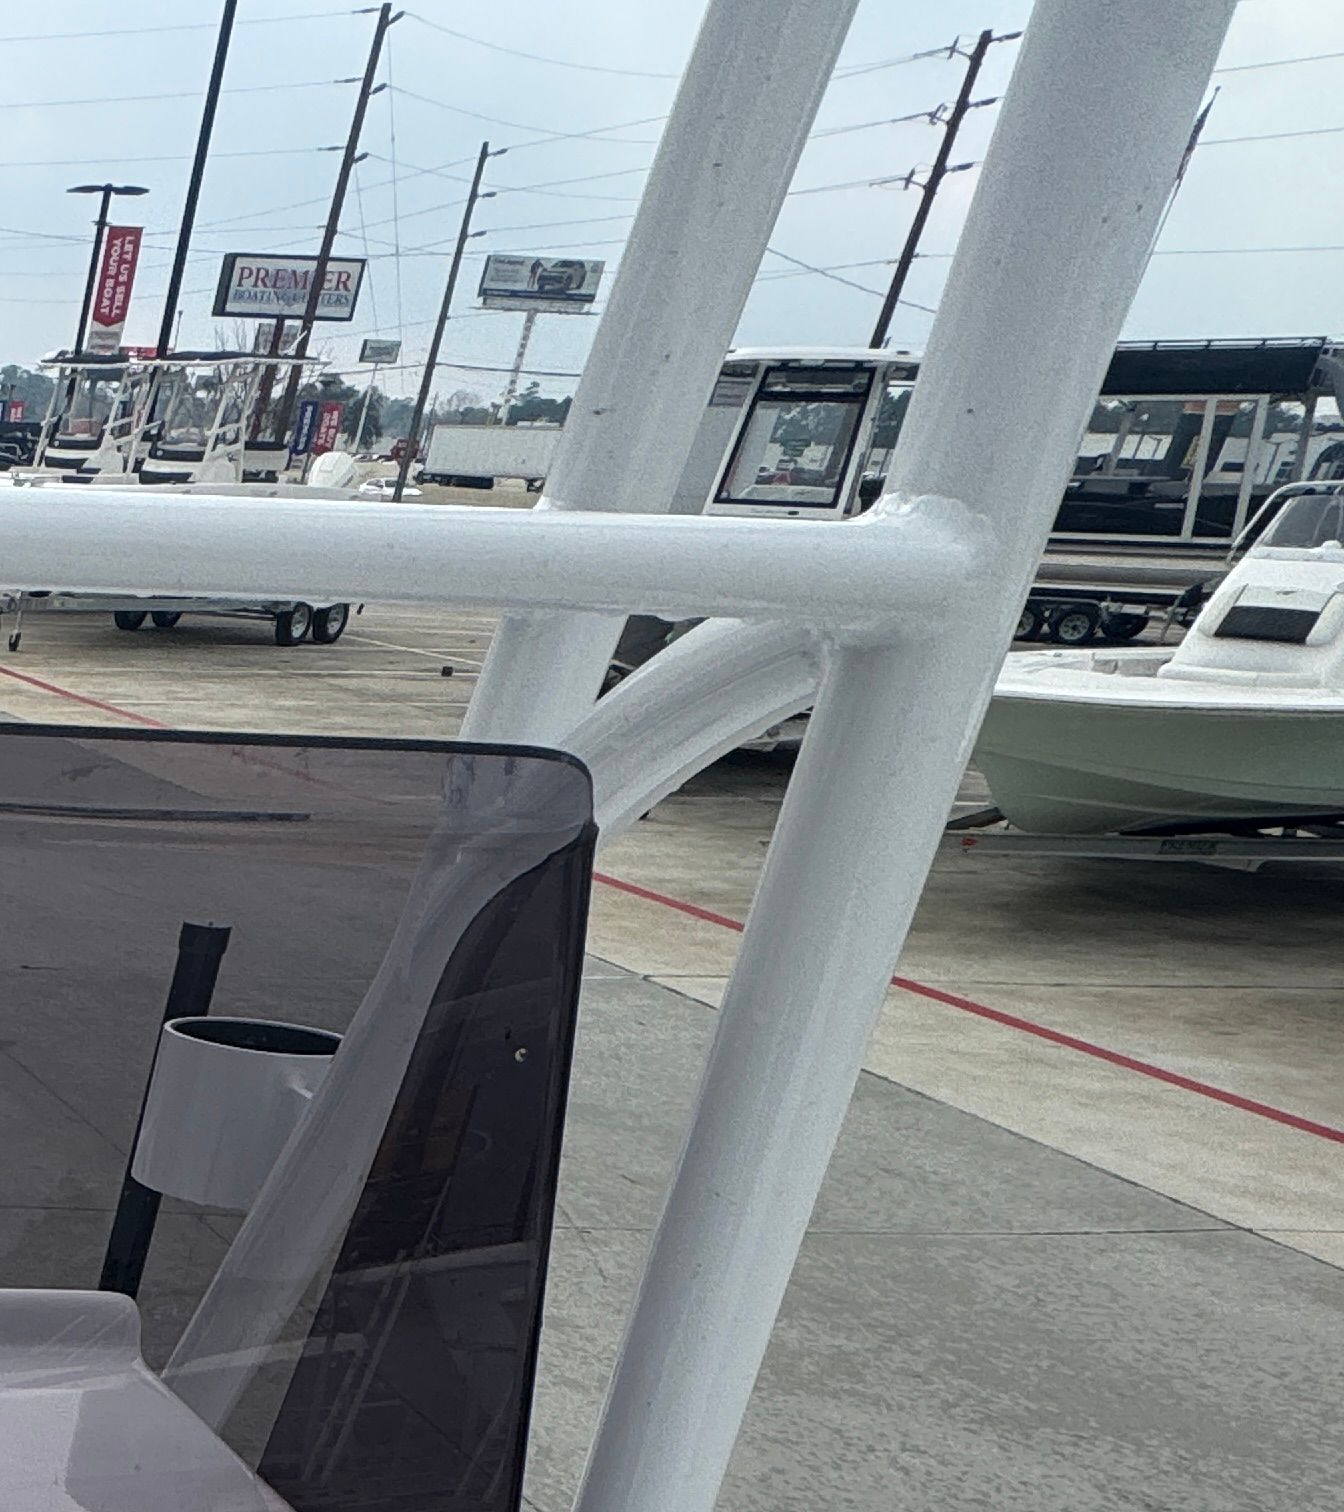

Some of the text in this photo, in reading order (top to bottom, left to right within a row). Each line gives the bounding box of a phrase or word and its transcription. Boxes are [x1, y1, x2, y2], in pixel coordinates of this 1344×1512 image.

[100, 237, 124, 315] YOUR BOAT
[111, 236, 135, 318] LET US SELL
[236, 266, 352, 292] PREMER
